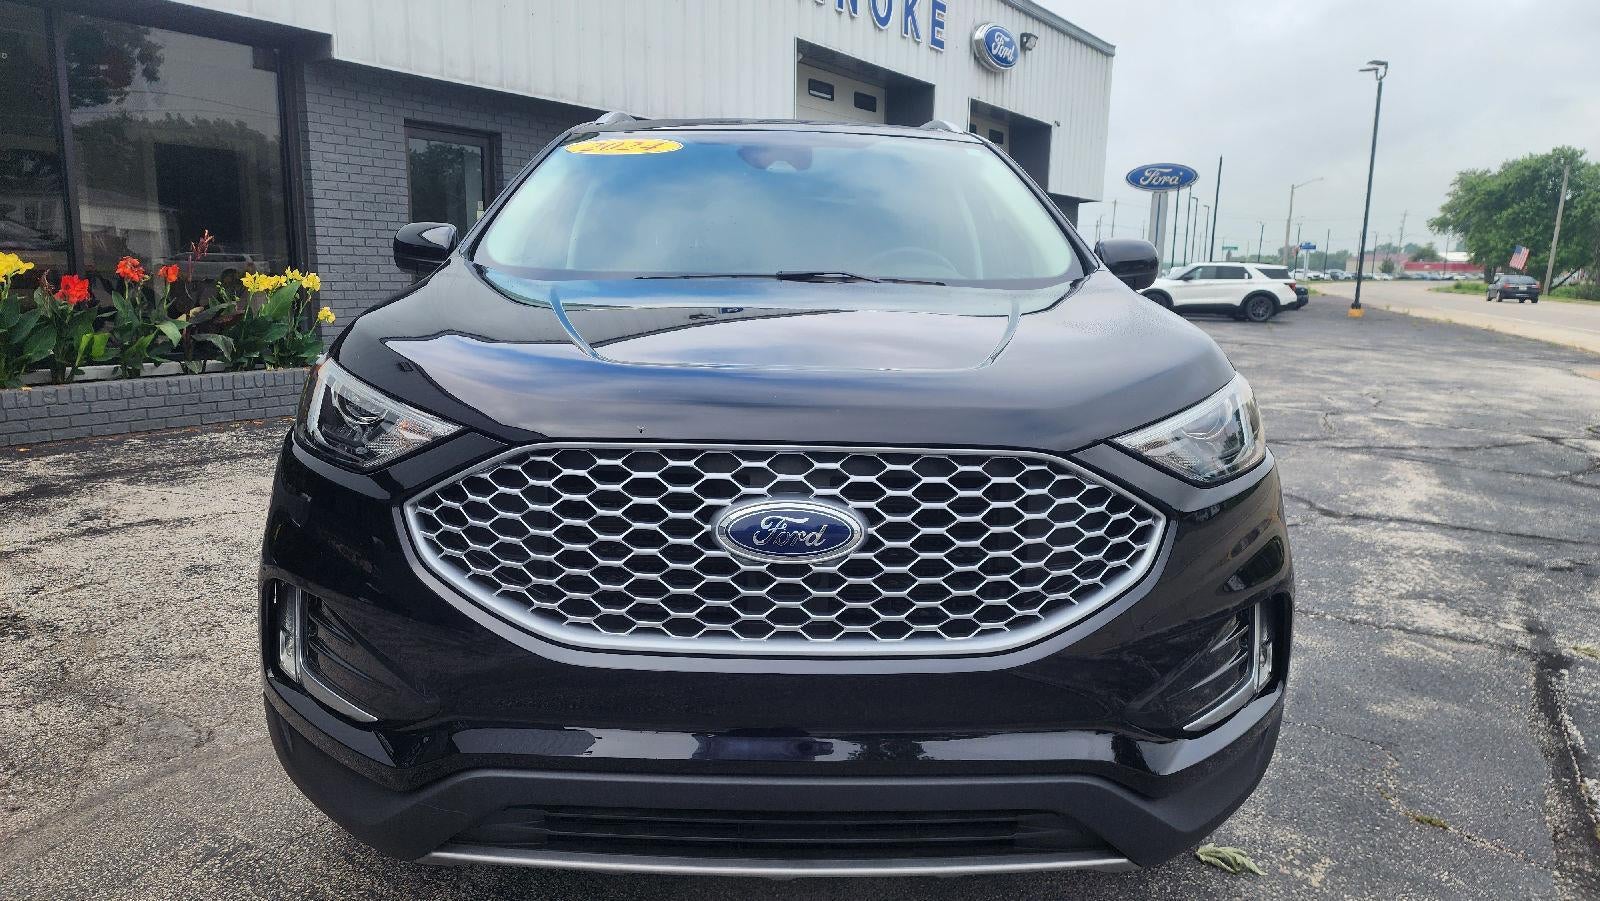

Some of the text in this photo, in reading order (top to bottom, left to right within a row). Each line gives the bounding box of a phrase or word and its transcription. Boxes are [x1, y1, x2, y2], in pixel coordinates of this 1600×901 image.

[813, 0, 948, 52] OKE
[991, 31, 1015, 62] Ford
[1139, 167, 1183, 186] Ford
[752, 515, 829, 547] Ford
